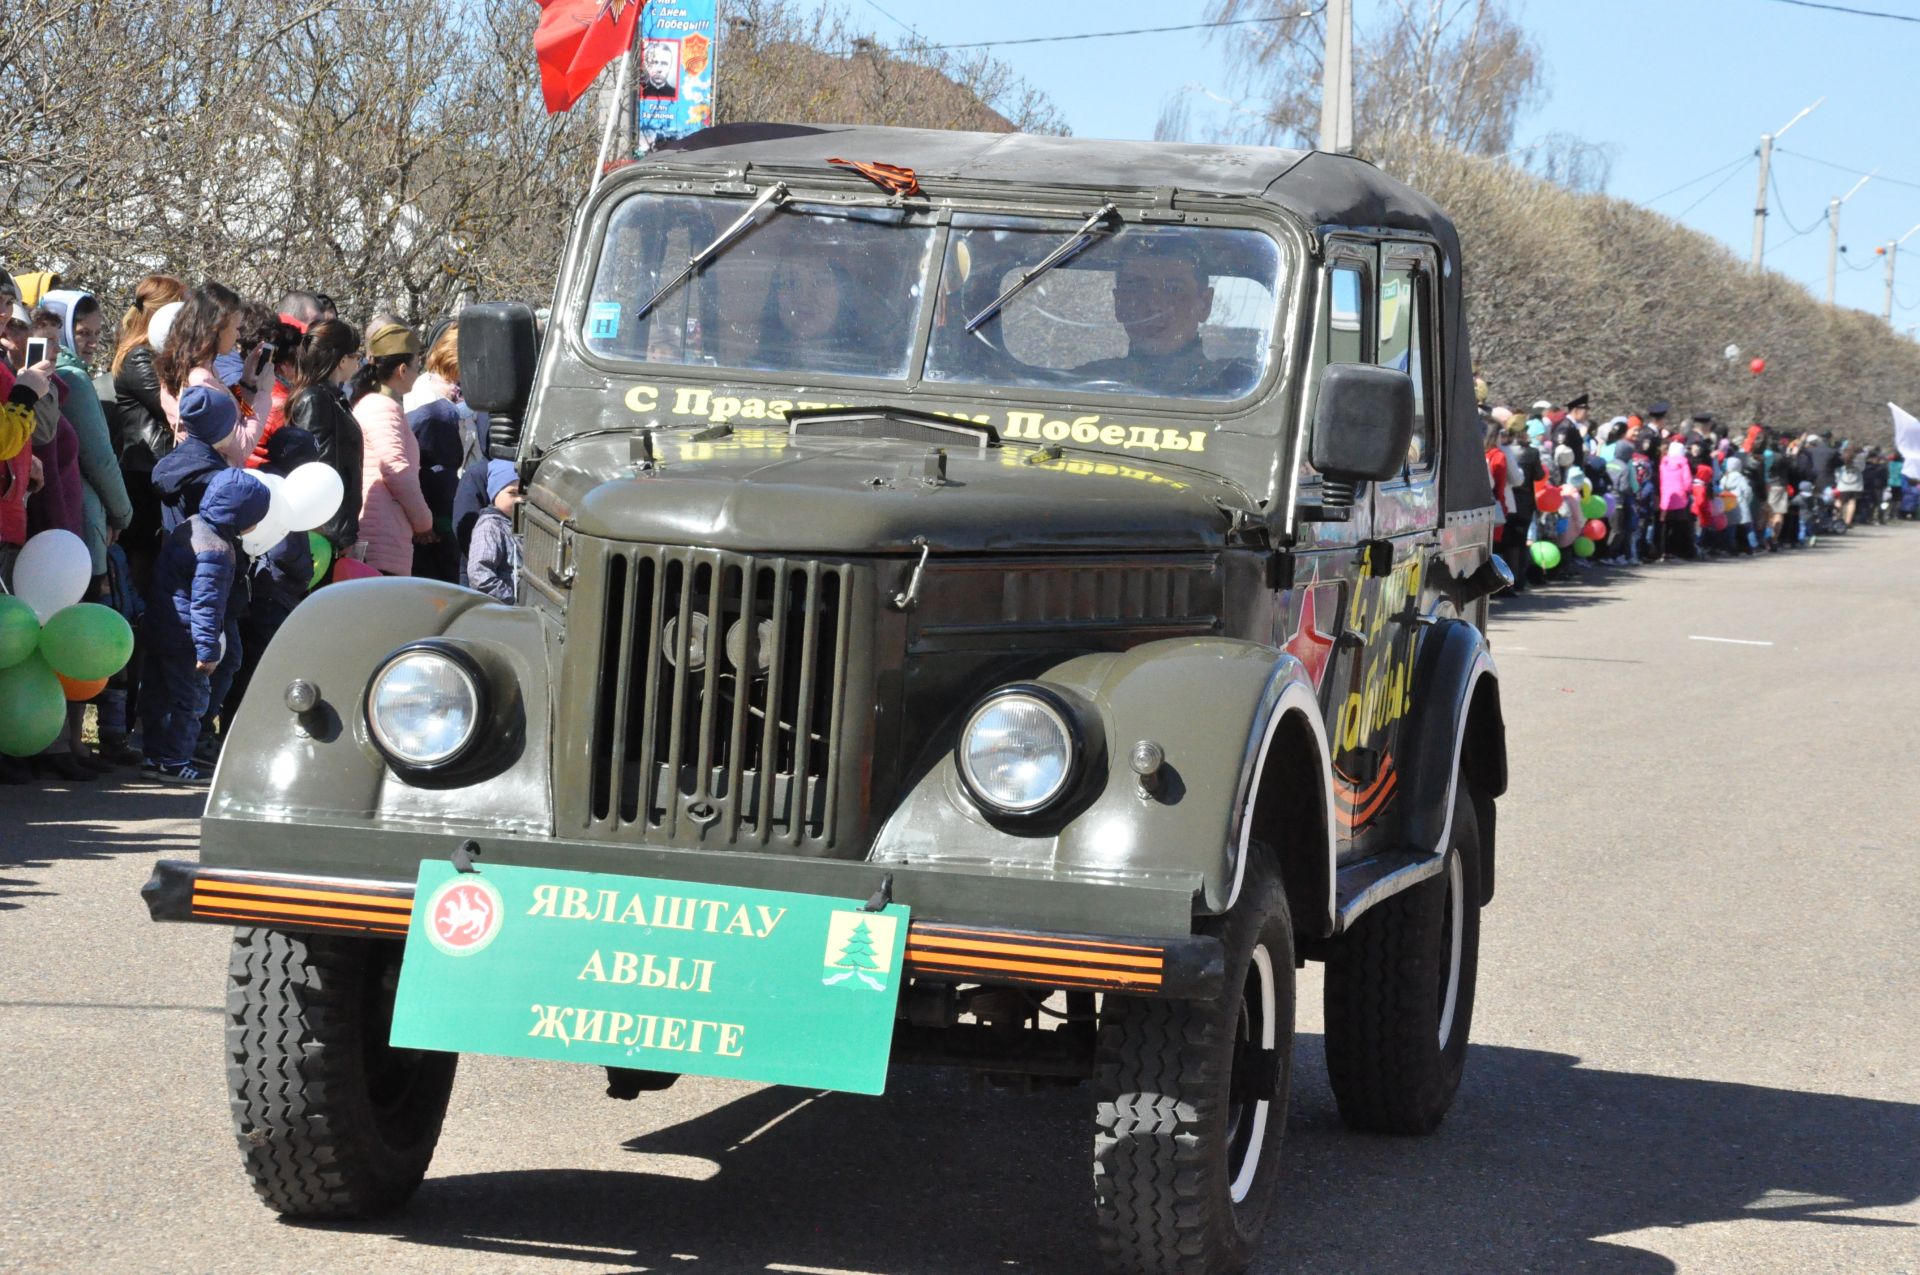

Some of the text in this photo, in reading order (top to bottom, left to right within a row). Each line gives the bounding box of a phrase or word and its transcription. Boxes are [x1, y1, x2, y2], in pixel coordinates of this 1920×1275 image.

[1003, 411, 1207, 452] Победы
[526, 884, 788, 938] ЯВЛАШТАУ
[576, 949, 717, 992] АВЫЛ
[527, 1003, 745, 1057] ҖИРЛЕГЕ
